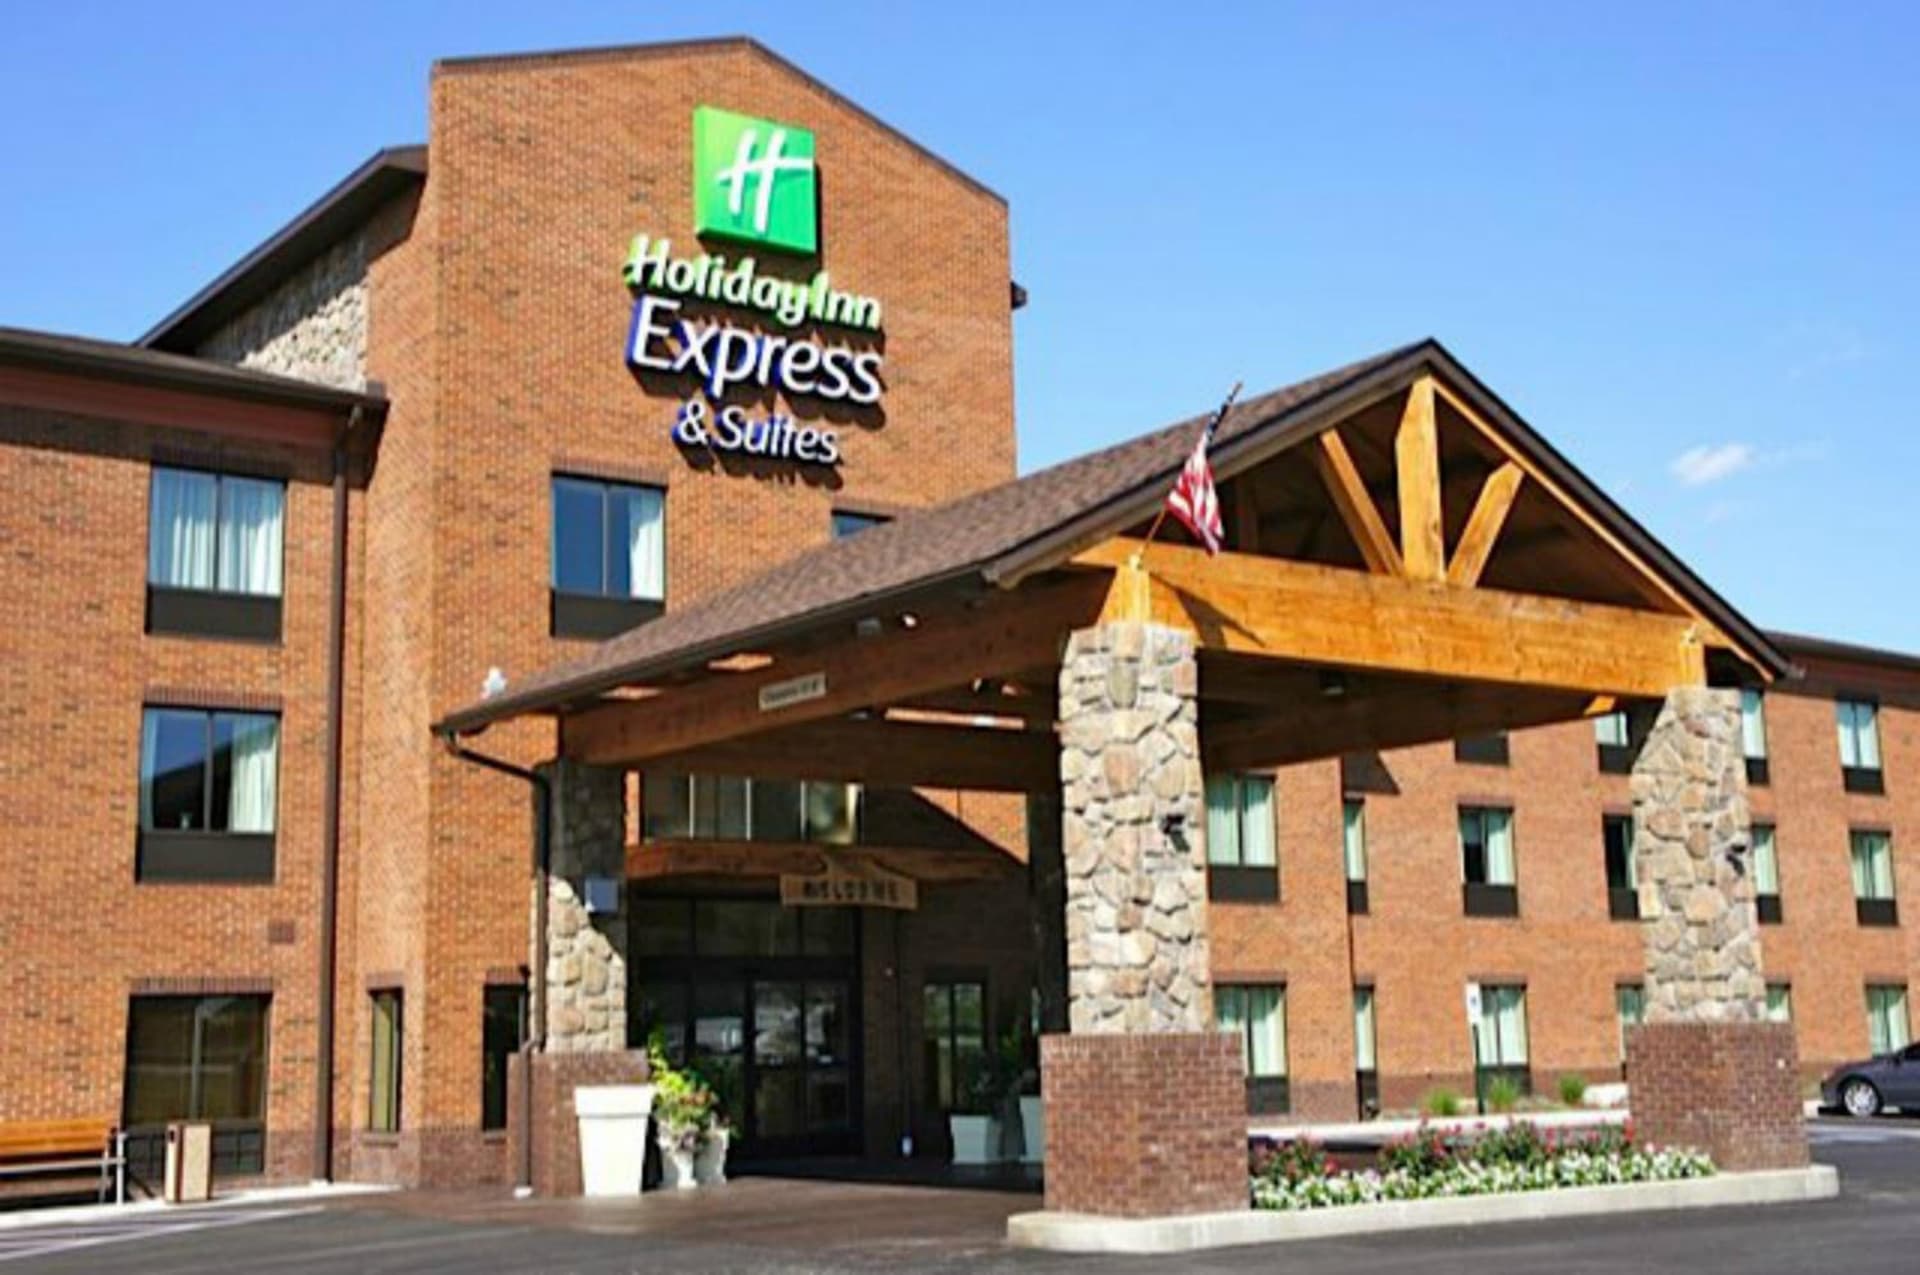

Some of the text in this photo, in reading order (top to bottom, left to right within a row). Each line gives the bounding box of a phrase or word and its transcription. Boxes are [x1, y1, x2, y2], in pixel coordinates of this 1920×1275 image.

[716, 128, 815, 234] H
[623, 233, 881, 330] Holiday Inn
[627, 295, 884, 403] Express
[673, 400, 839, 463] & Suites
